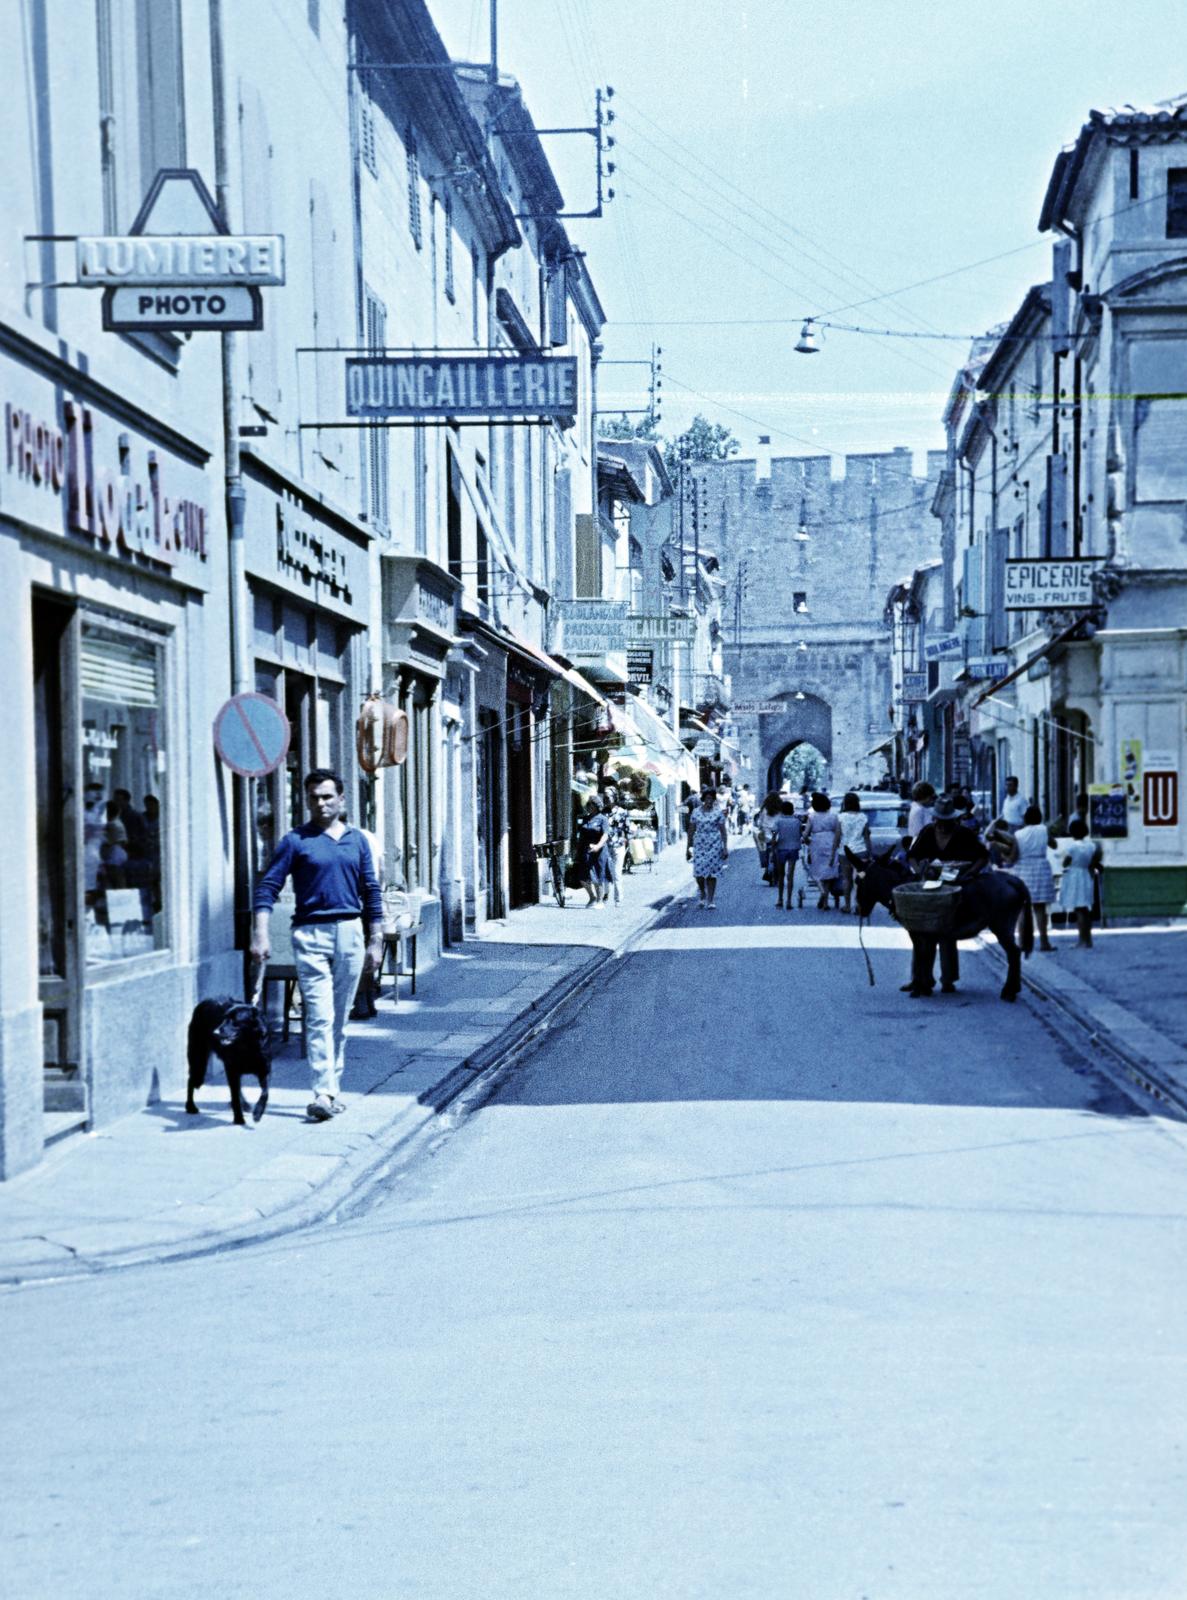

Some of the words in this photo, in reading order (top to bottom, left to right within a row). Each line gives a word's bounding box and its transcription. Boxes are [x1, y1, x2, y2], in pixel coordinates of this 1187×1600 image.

[84, 241, 272, 276] LUMIERE
[138, 295, 226, 315] PHOTO
[350, 363, 575, 412] QUINCAILLERIE
[5, 401, 64, 494] PHOTO
[1007, 564, 1090, 588] EPICERIE
[1148, 777, 1174, 821] LU
